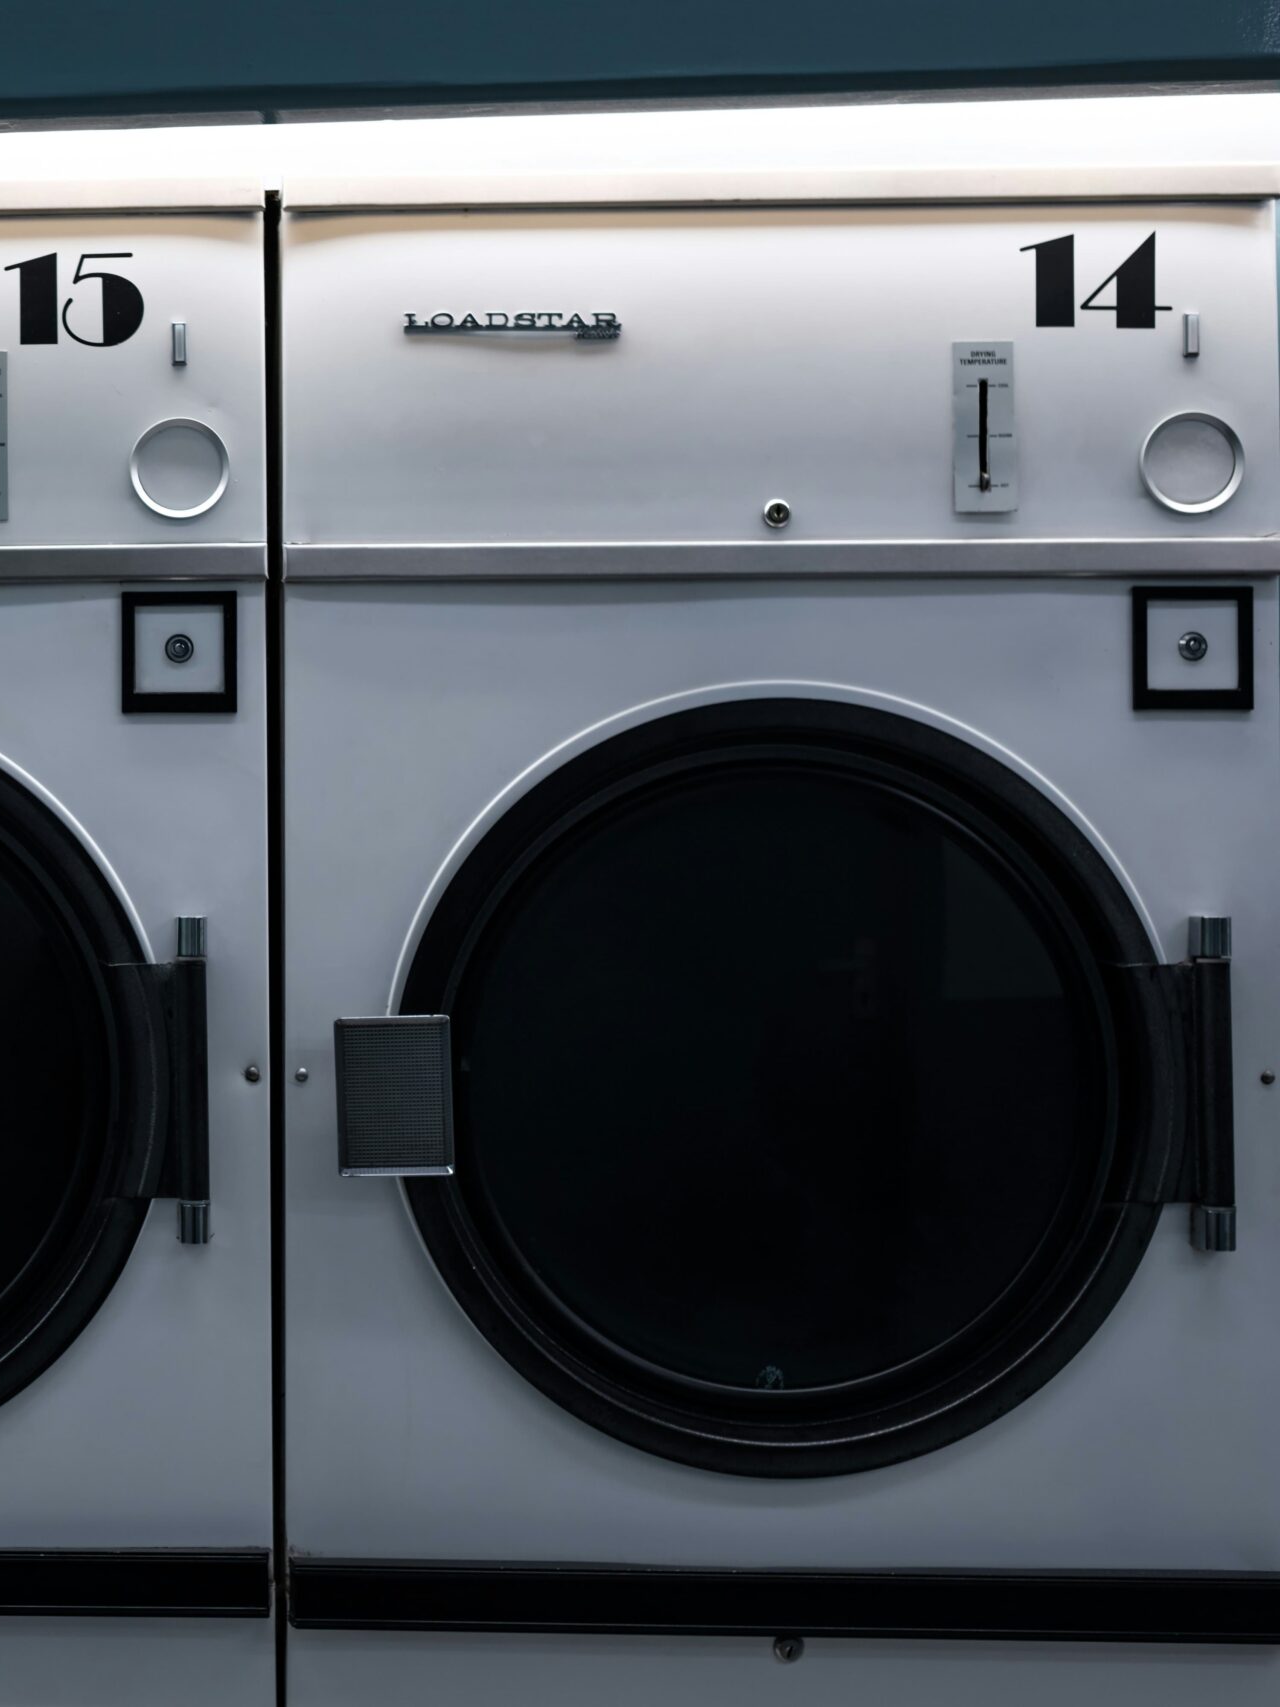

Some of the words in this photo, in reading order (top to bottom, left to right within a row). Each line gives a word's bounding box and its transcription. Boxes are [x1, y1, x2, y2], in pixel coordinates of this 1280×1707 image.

[4, 252, 145, 348] 15
[1020, 231, 1173, 329] 14
[404, 312, 622, 330] LOADSTAR
[960, 358, 1008, 366] TEMPERATURE
